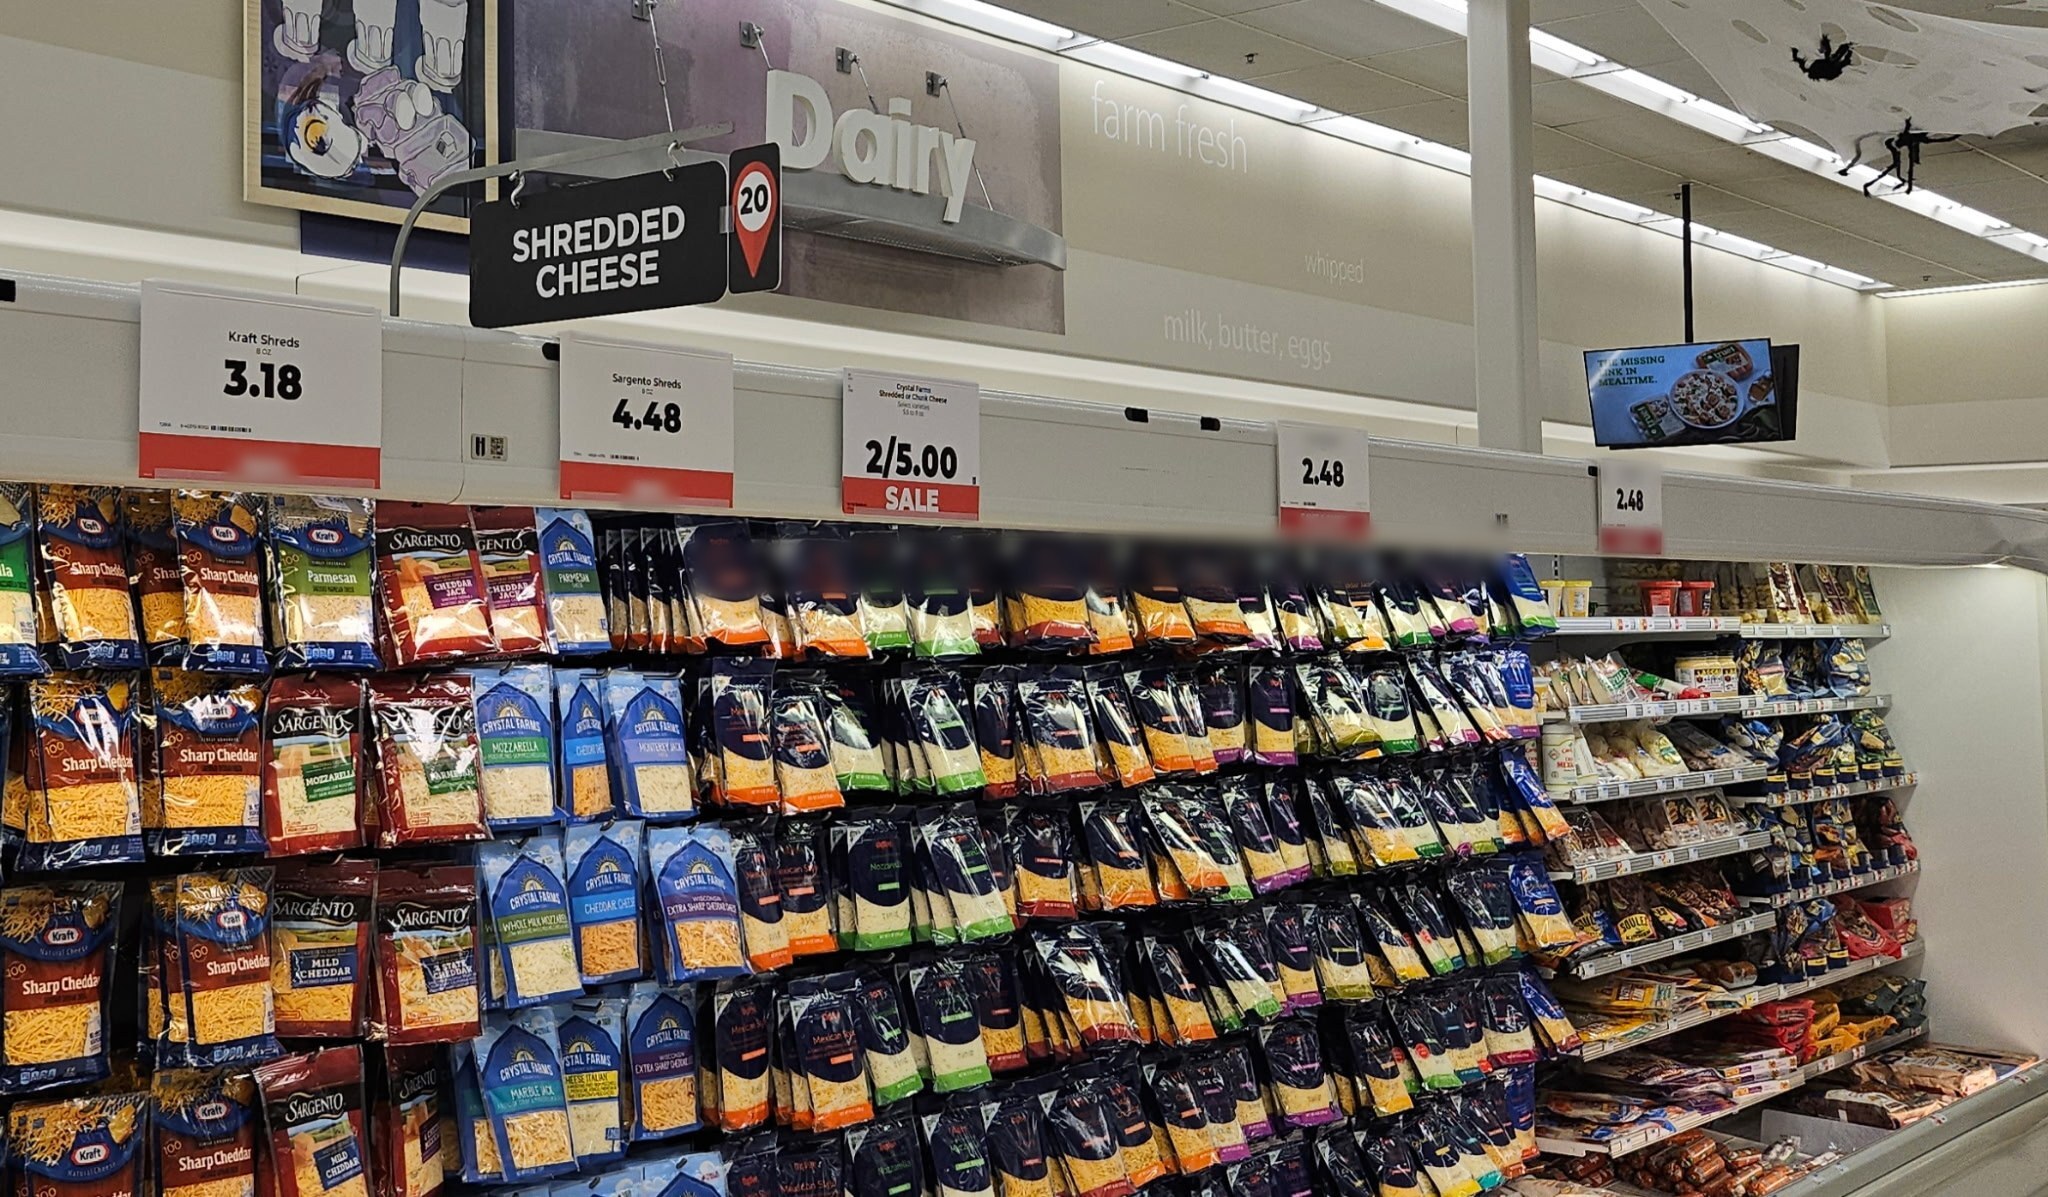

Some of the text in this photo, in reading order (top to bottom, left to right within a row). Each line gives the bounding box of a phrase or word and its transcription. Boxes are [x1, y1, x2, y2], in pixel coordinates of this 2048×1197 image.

[1091, 81, 1249, 173] farm fresh
[766, 70, 977, 223] Dairy
[740, 184, 769, 216] 20
[512, 205, 686, 263] SHREDDED
[535, 250, 660, 298] CHEESE
[1304, 251, 1364, 284] whipped
[228, 331, 300, 348] Kraft Shreds
[1164, 310, 1333, 370] milk, butter, eggs
[1620, 355, 1665, 366] MISSING
[1625, 367, 1637, 375] IN
[223, 359, 303, 401] 3.18
[612, 373, 681, 389] Sargento Shreds
[879, 389, 904, 400] Shredded
[896, 383, 915, 393] Crystal
[612, 398, 682, 433] 4.48
[865, 436, 958, 479] 2/5.00
[1302, 457, 1345, 488] 2.48
[885, 485, 939, 512] SALE
[1616, 488, 1644, 512] 2.48
[82, 520, 101, 533] Kraft
[214, 527, 234, 539] Kraft
[315, 531, 335, 542] Kraft
[389, 532, 462, 551] SARGENTO
[478, 536, 524, 551] GENTO
[547, 552, 573, 566] CRYSTAL
[70, 562, 100, 577] Sharp
[153, 567, 181, 580] Shar
[200, 567, 227, 584] Sharp
[307, 570, 358, 584] Parmesan
[433, 580, 473, 592] CHEDDAR
[558, 573, 590, 584] PARMESAN
[446, 587, 467, 597] JACK
[482, 718, 541, 733] CRYSTAL FARMS
[634, 721, 659, 735] CRYSTAL
[492, 741, 539, 752] MOZZARELLA
[180, 749, 258, 764] Sharp Cheddar
[62, 757, 98, 773] Sharp
[585, 873, 632, 891] CRYSTAL FARMS
[674, 875, 726, 890] CRYSTAL FARMS
[273, 900, 355, 916] SARGENTO
[509, 891, 561, 910] CRYSTAL FARMS
[584, 900, 617, 915] CHEDDAR
[396, 905, 470, 927] SARGENTO
[667, 903, 688, 916] EXTRA
[688, 902, 706, 912] SHARP
[502, 920, 528, 933] WHOLE
[52, 930, 75, 942] Kraft
[191, 946, 209, 961] 100
[206, 960, 237, 976] Sharp
[311, 959, 340, 968] MILD
[299, 967, 351, 979] CHEDDAR
[22, 978, 60, 995] Sharp
[645, 1032, 672, 1048] CRYSTAL
[586, 1054, 612, 1067] FARMS
[499, 1064, 554, 1081] CRYSTAL FARMS
[635, 1063, 655, 1075] EXTRA
[585, 1073, 608, 1083] ITALIAN
[510, 1088, 540, 1099] MARBLE
[201, 1105, 223, 1117] Kraft
[285, 1092, 344, 1123] SARGENTO
[79, 1147, 101, 1160] Kraft
[330, 1151, 349, 1166] MILD
[179, 1154, 214, 1172] Sharp
[325, 1156, 360, 1178] CHEDDAR
